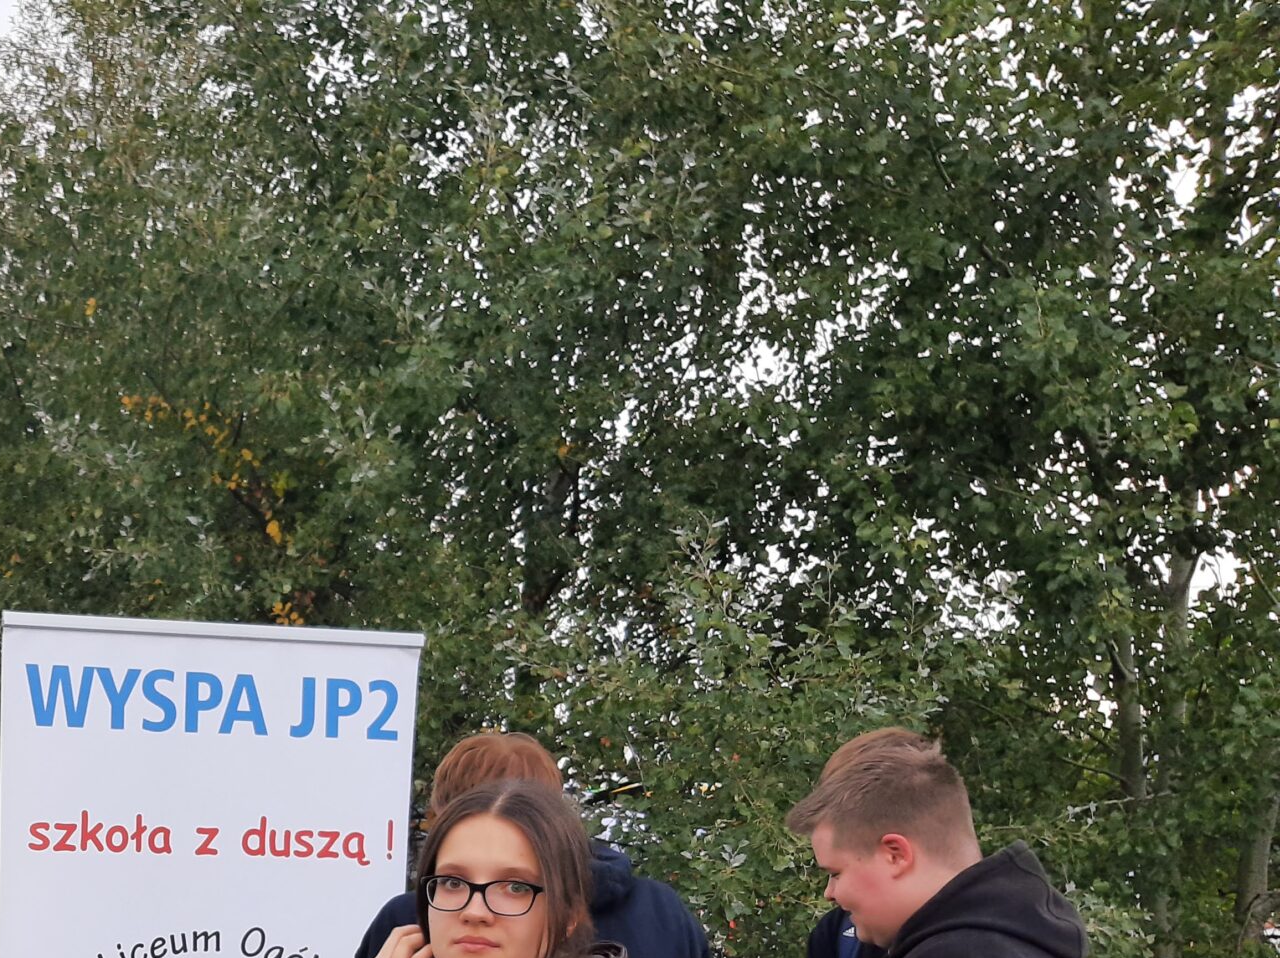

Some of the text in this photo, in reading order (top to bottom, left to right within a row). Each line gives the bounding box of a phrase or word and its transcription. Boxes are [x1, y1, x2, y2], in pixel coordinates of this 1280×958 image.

[25, 663, 399, 741] WYSPA JP2
[28, 810, 172, 855] szkoła
[195, 827, 219, 855] z
[241, 816, 371, 866] duszą
